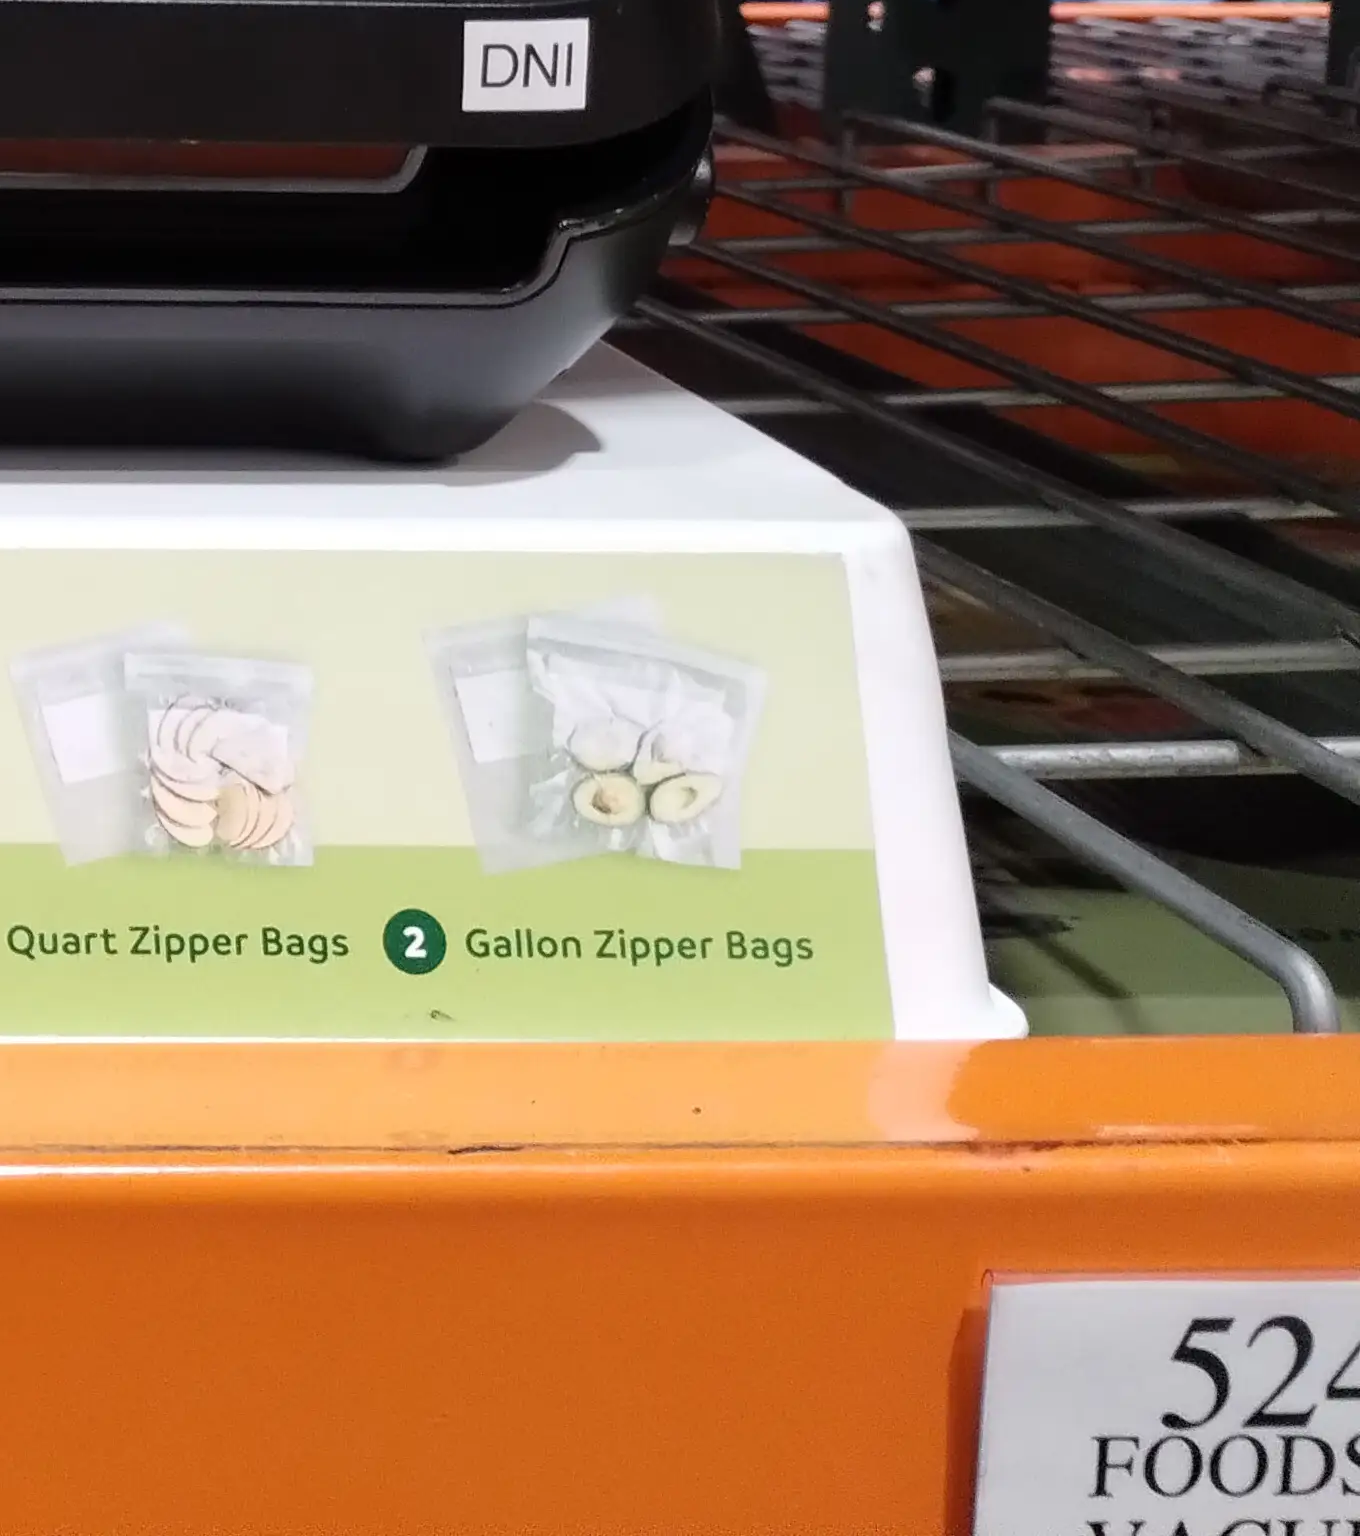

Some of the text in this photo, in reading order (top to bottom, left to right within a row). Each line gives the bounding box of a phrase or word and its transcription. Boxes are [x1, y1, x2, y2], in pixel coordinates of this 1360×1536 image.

[480, 41, 574, 89] DNI
[5, 924, 118, 961] Quart
[127, 923, 249, 964] Zipper
[260, 925, 351, 965] Bags
[401, 925, 815, 968] 2 Gallon Zipper Bags
